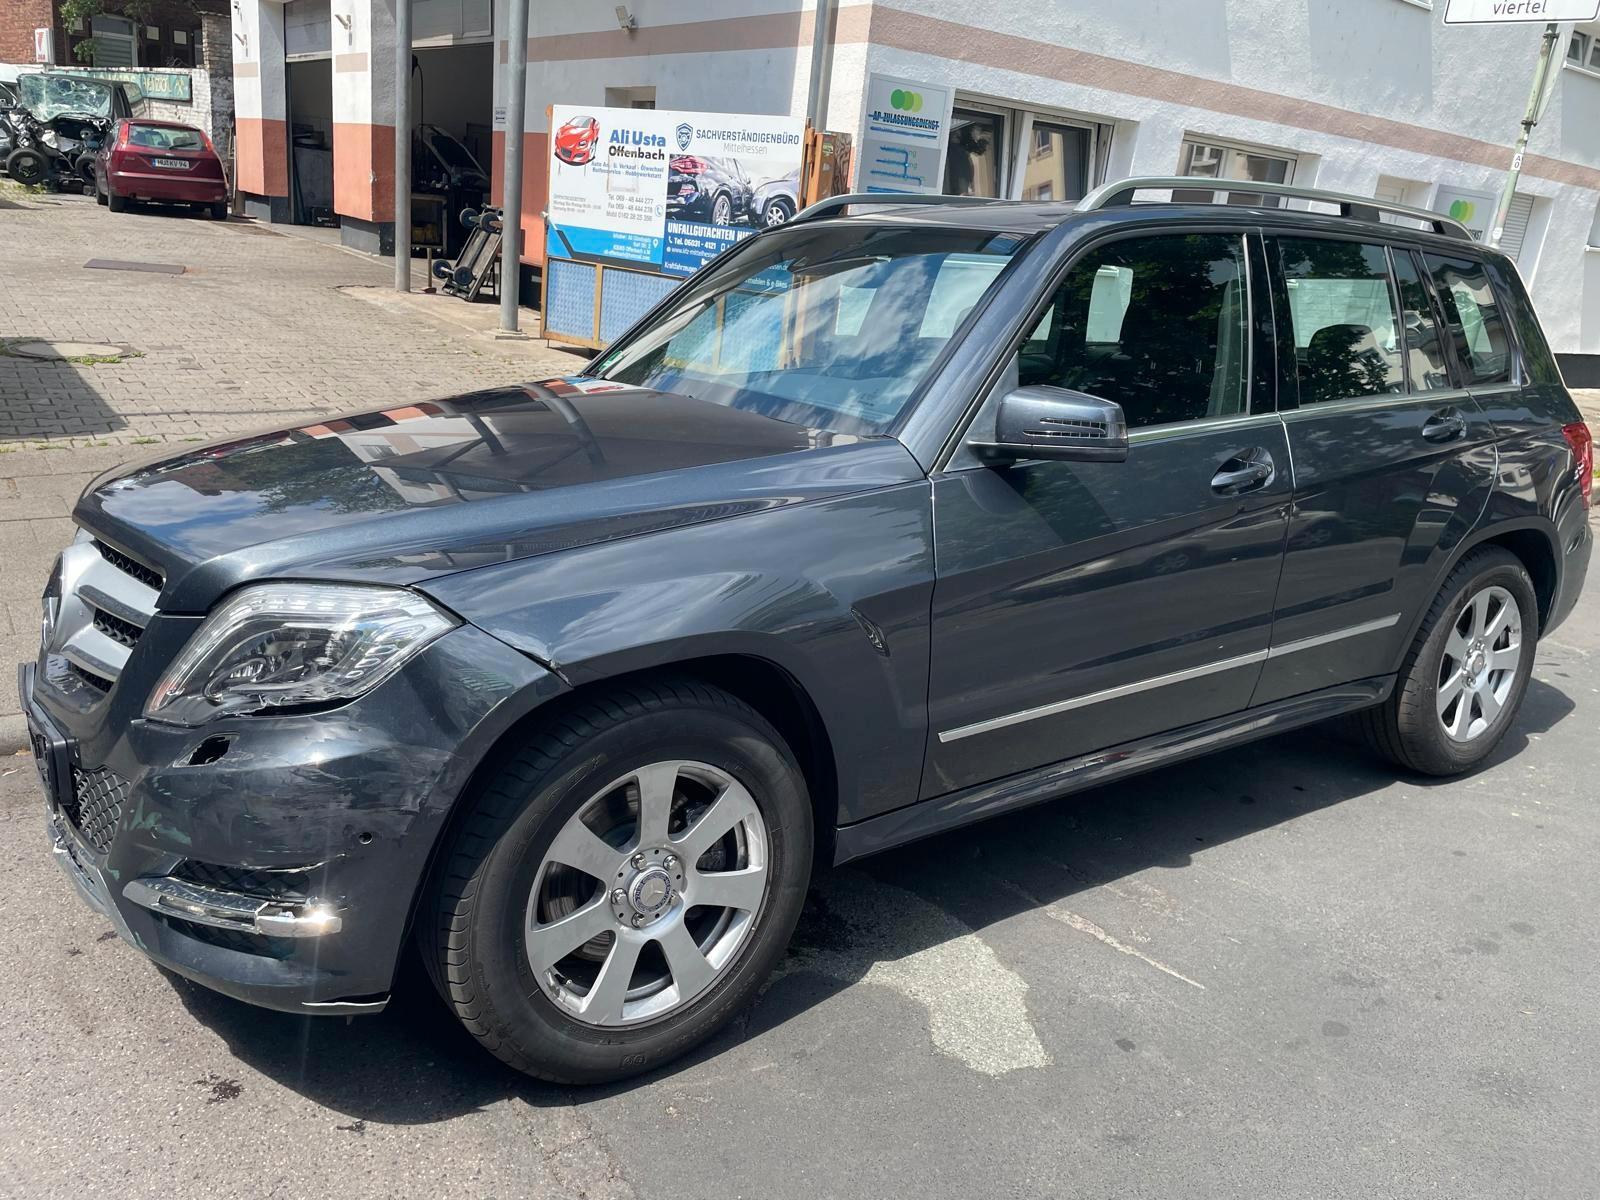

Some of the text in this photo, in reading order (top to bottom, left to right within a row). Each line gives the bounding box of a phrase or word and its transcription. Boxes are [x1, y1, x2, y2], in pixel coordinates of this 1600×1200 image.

[1493, 0, 1548, 15] viertel
[609, 129, 666, 147] Ali Usta
[696, 129, 800, 145] SACHVERSTÄNDIGENBÜRO
[608, 145, 665, 160] Offenbach
[722, 142, 768, 155] Mittelhessen
[179, 160, 187, 168] 94
[625, 170, 662, 179] Hobbywerkstatt
[667, 222, 736, 241] UNFALLGUTACHTEN
[674, 237, 684, 246] Tel.
